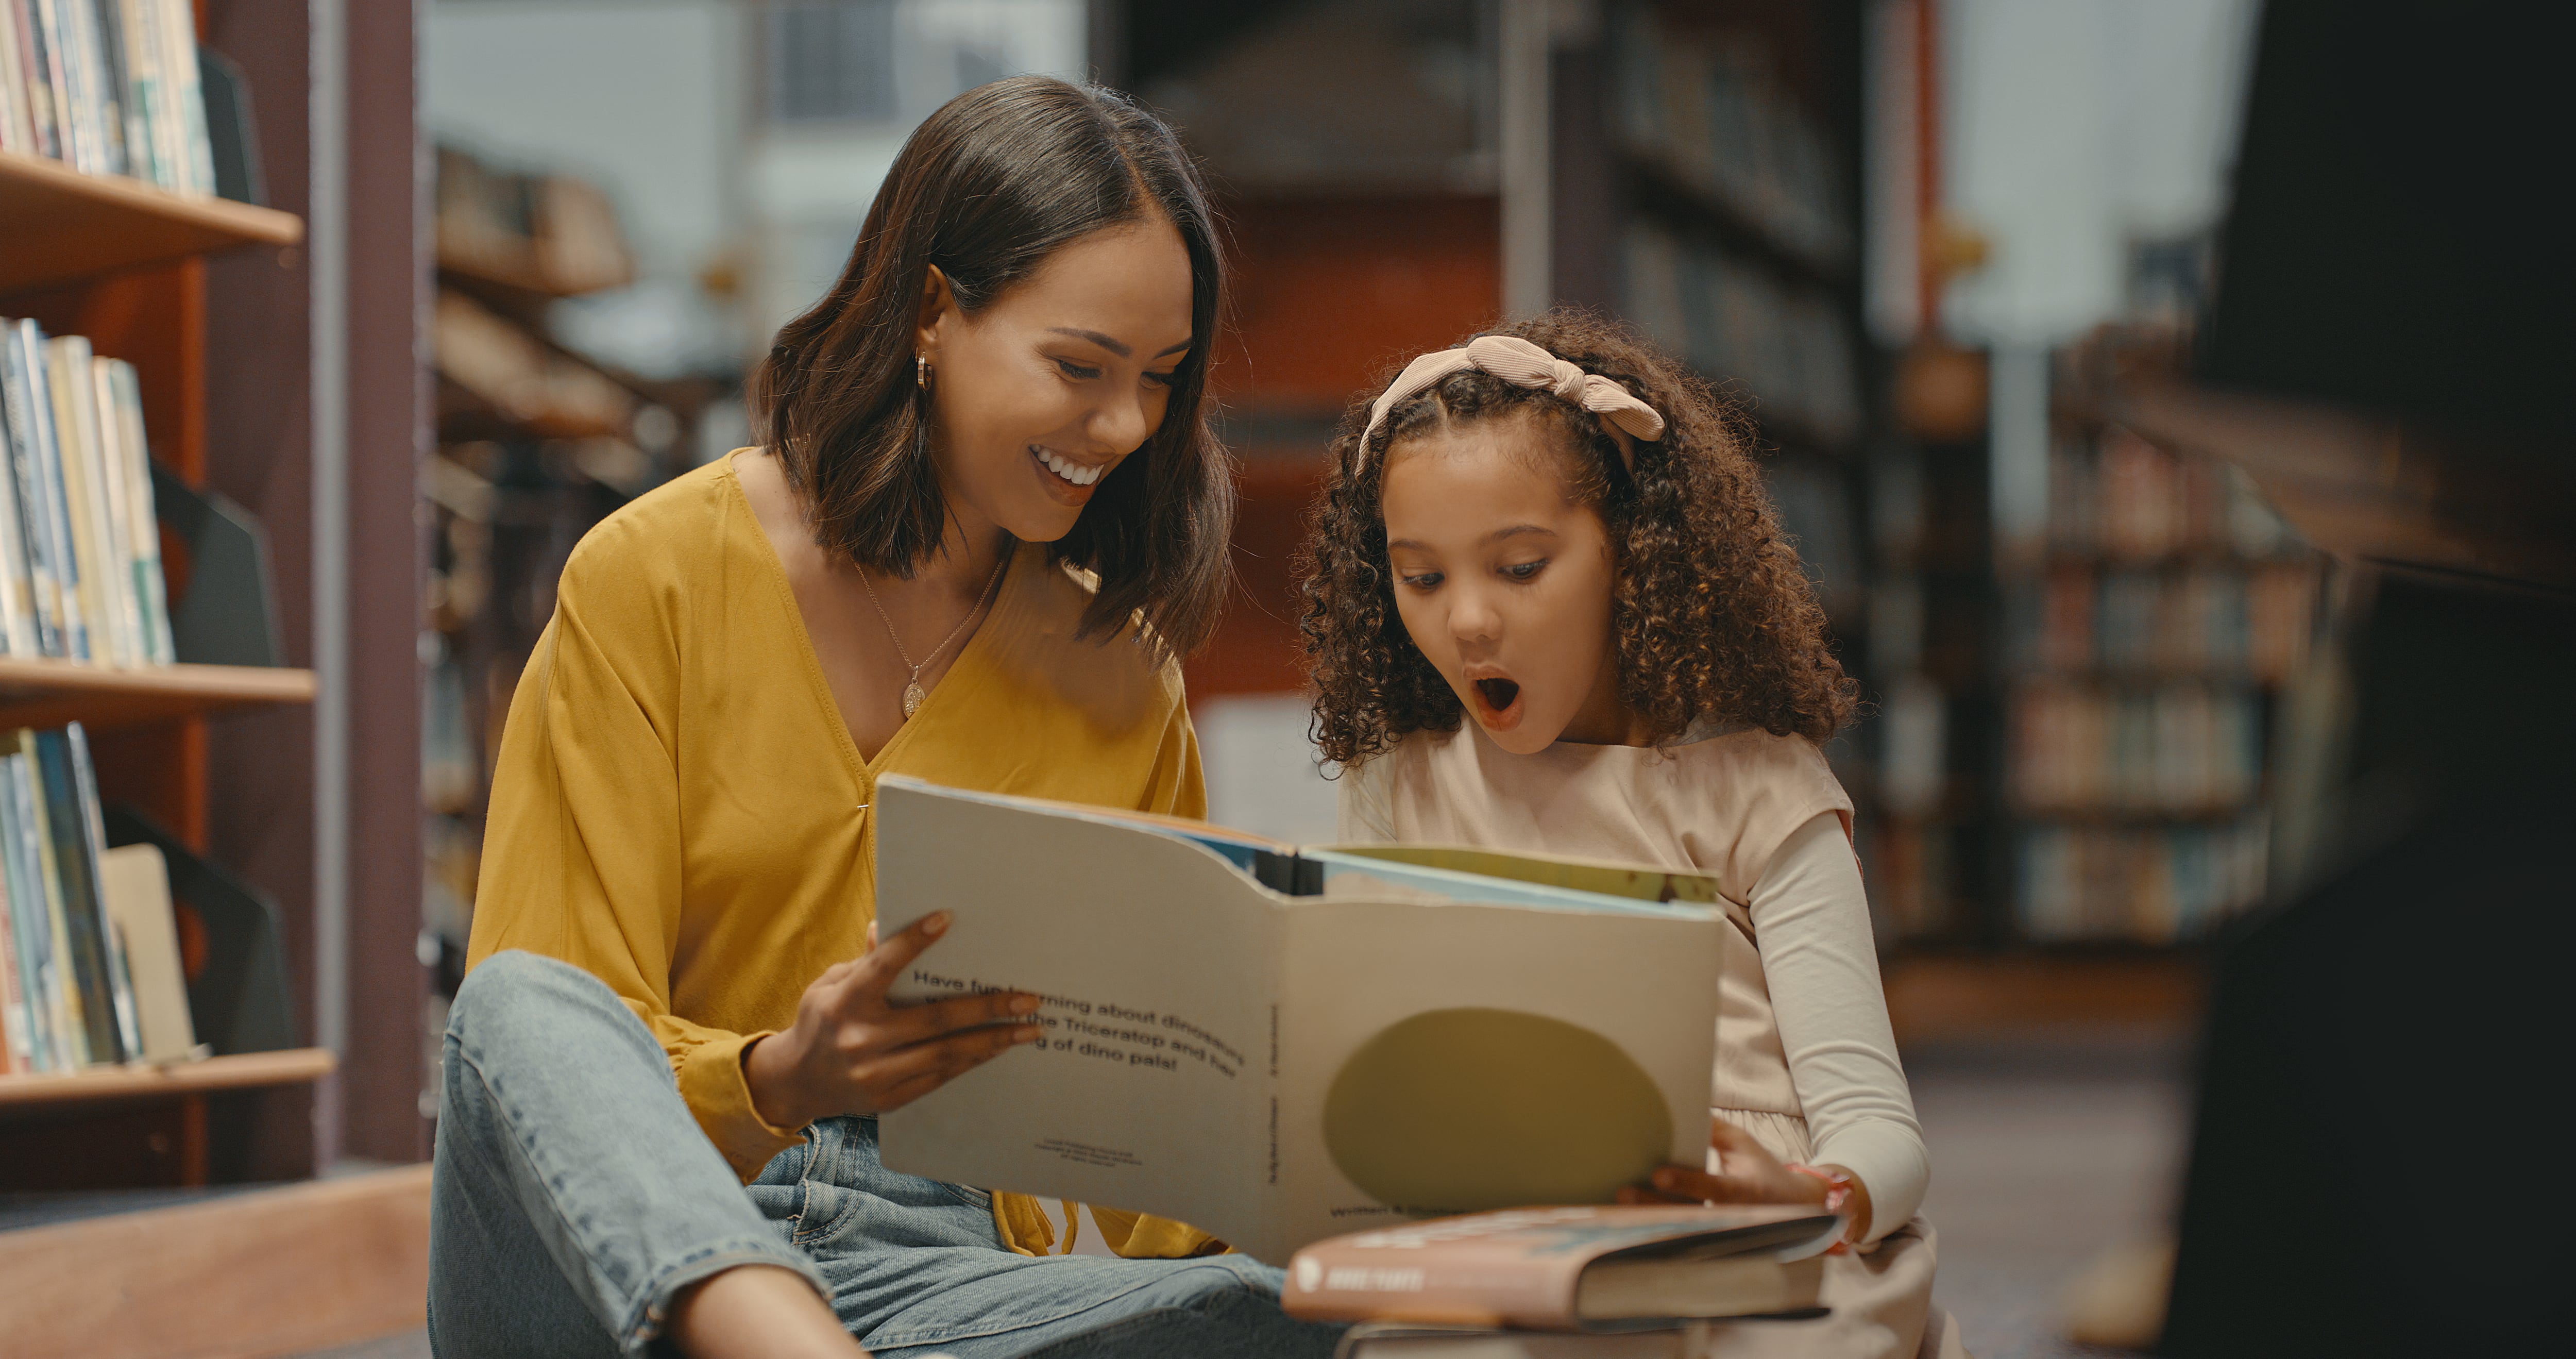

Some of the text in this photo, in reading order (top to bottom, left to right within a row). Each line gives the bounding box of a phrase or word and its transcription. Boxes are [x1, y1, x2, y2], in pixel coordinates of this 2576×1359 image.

[913, 970, 1245, 1067] Have fun rning about dinosaurs
[1027, 1012, 1057, 1029] the
[1064, 1016, 1164, 1048] Triceratop
[1171, 1038, 1206, 1062] and
[1053, 1038, 1073, 1051] of
[1079, 1042, 1124, 1061] dino
[1129, 1052, 1177, 1072] pals!
